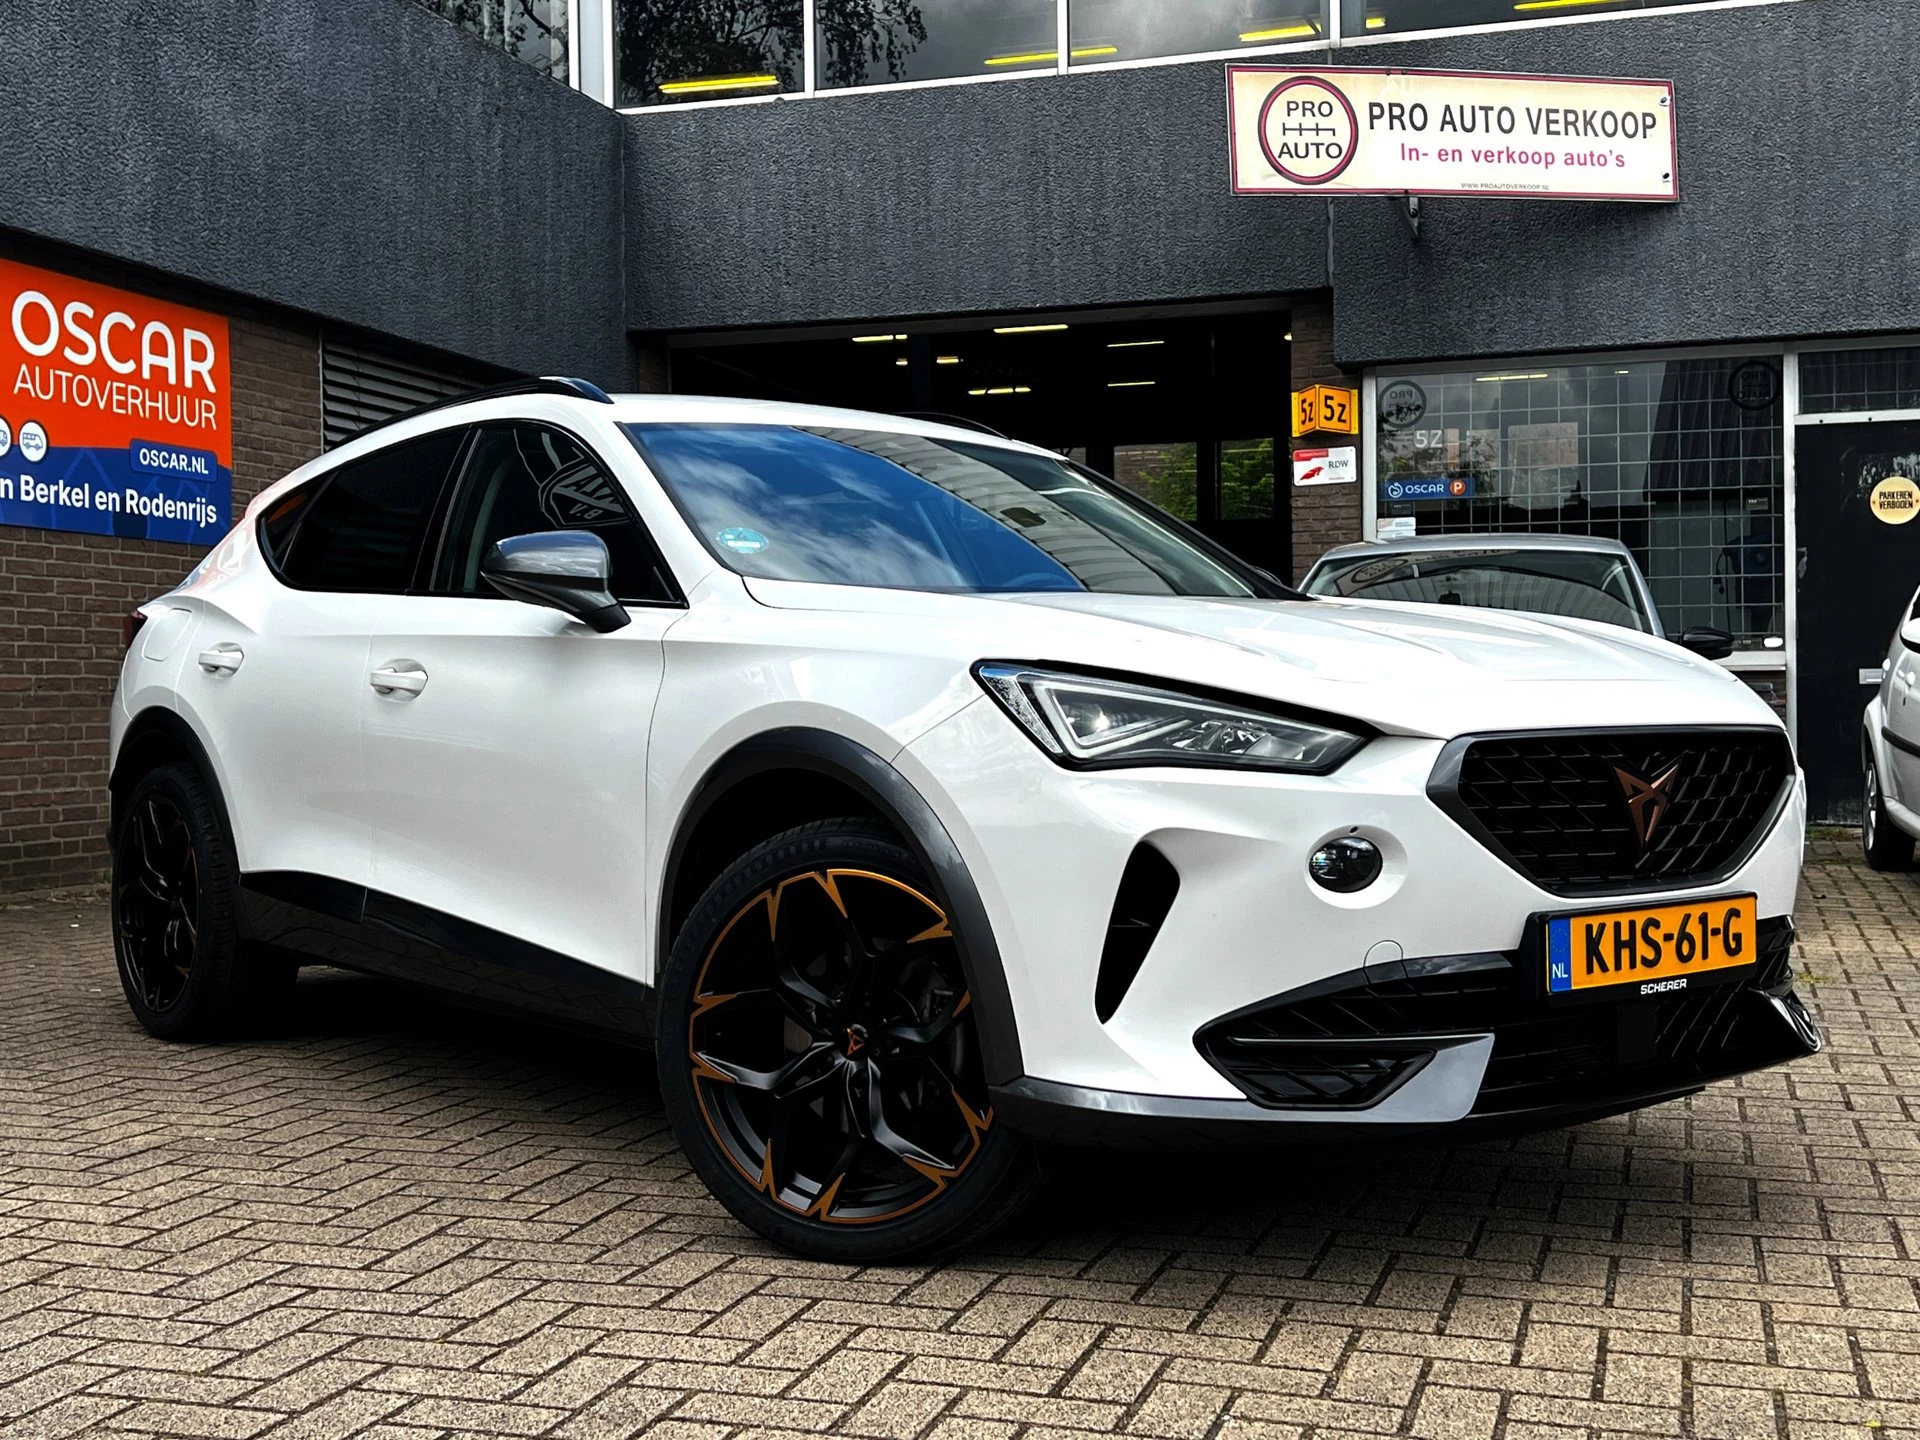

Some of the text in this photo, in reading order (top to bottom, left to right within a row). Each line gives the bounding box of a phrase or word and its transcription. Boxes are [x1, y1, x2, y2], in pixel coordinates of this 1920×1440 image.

[1286, 100, 1333, 117] PRO
[1368, 102, 1656, 139] PRO AUTO VERKOOP
[1278, 142, 1343, 159] AUTO
[1401, 143, 1625, 169] In- en verkoop auto's
[11, 290, 217, 393] OSCAR
[13, 363, 217, 431] AUTOVERHUUR
[139, 448, 209, 475] OSCAR.NL
[1328, 460, 1349, 469] RDW
[1405, 484, 1445, 493] OSCAR
[1879, 490, 1913, 500] PARKEREN
[20, 474, 90, 509] Berkel
[95, 491, 120, 512] en
[125, 488, 217, 528] Rodenrijs
[1879, 500, 1914, 509] VERBODEN
[1585, 907, 1743, 975] KHS-61-G
[1552, 963, 1569, 979] NL
[1640, 979, 1687, 995] SCHERER
